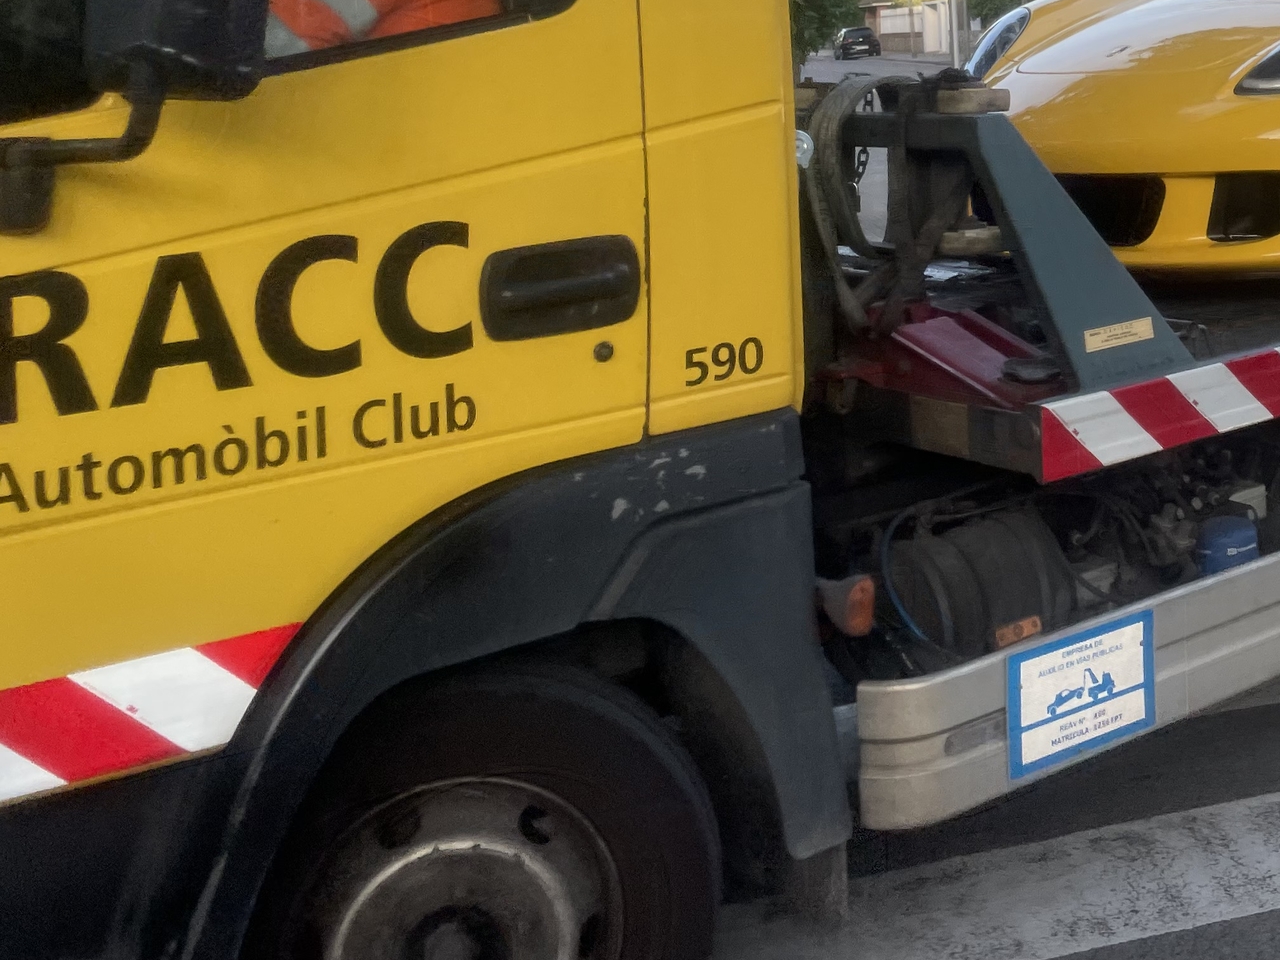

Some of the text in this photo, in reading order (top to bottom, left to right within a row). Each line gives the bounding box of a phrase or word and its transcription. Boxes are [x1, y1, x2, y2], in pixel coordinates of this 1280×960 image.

[0, 221, 473, 424] RACC
[685, 337, 764, 386] 590
[0, 384, 477, 514] Automòbil Club
[1038, 664, 1064, 678] AUXILIO
[1066, 659, 1076, 670] EN
[1062, 639, 1103, 659] EMPRESA DE
